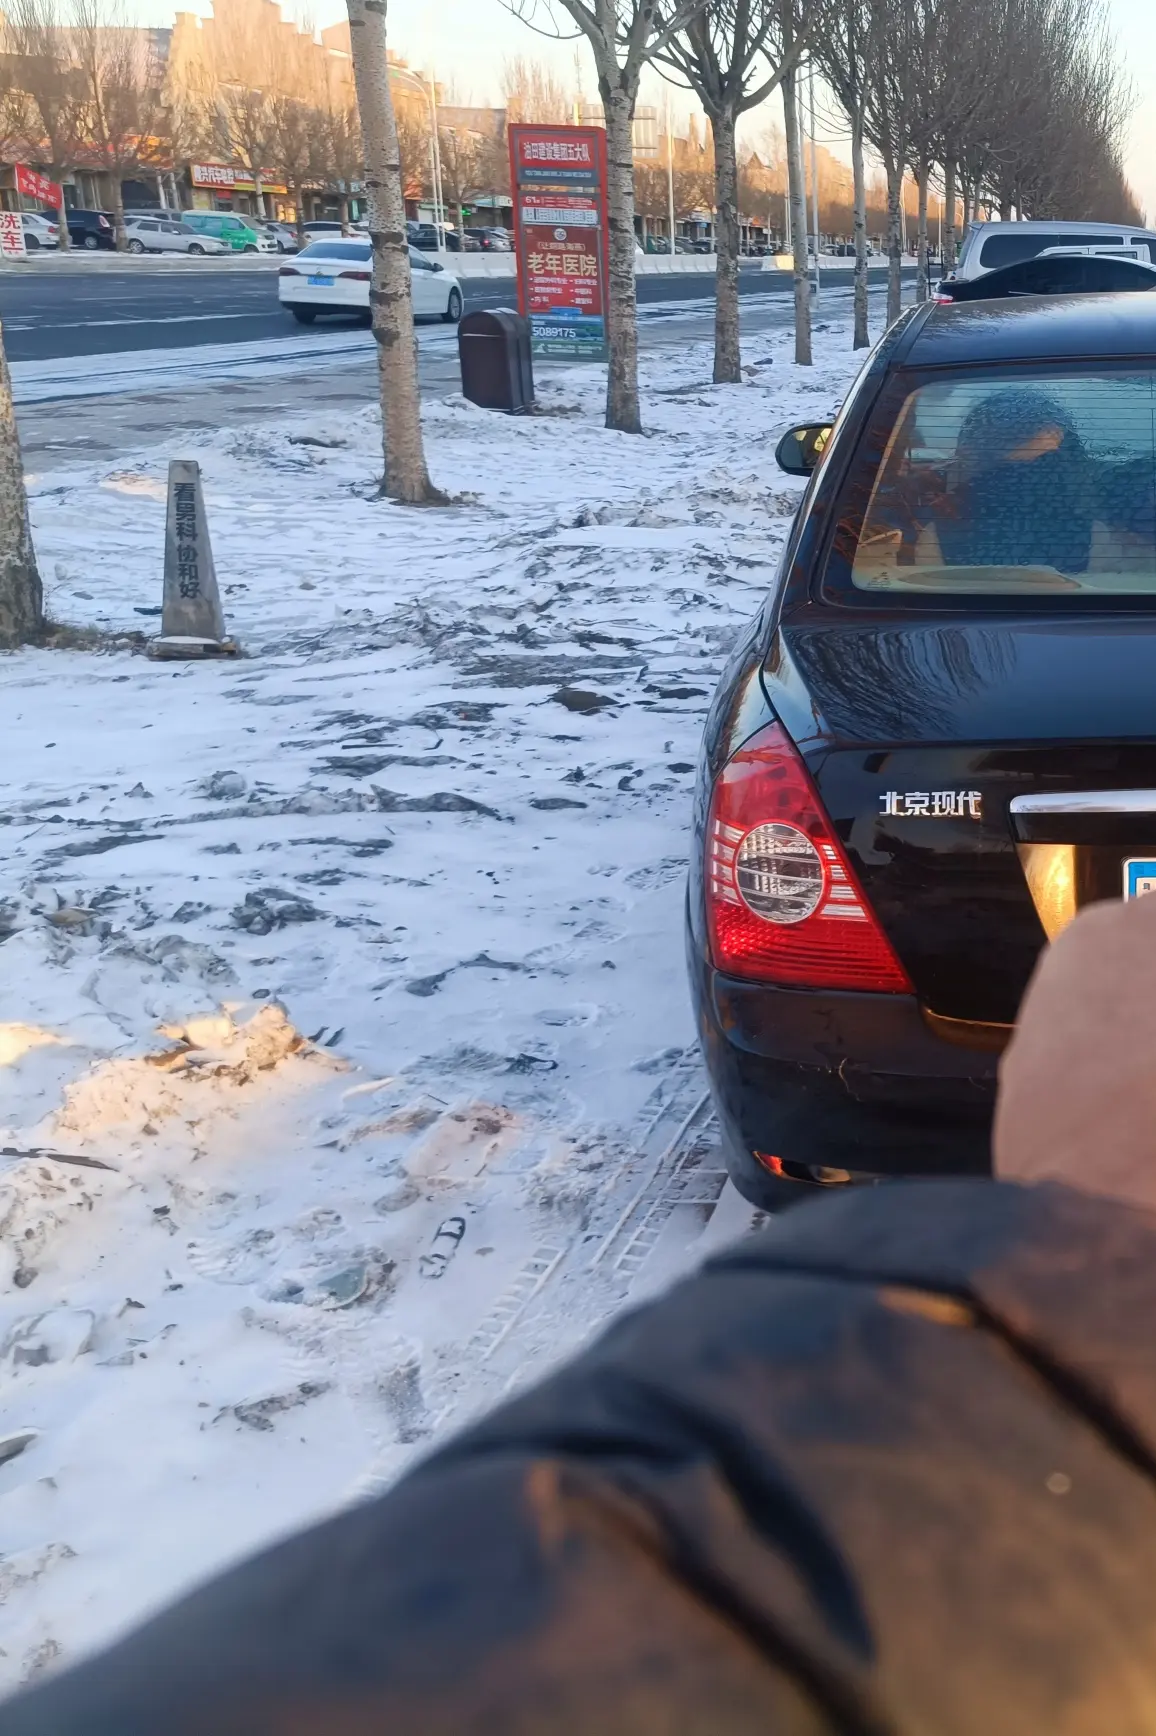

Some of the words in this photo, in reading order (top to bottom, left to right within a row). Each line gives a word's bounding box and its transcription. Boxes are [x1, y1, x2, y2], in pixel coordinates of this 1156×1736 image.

[528, 252, 598, 276] 老年医院
[532, 327, 576, 338] 5089175
[174, 482, 200, 599] 看男科协和好
[879, 791, 982, 818] 北京现代
